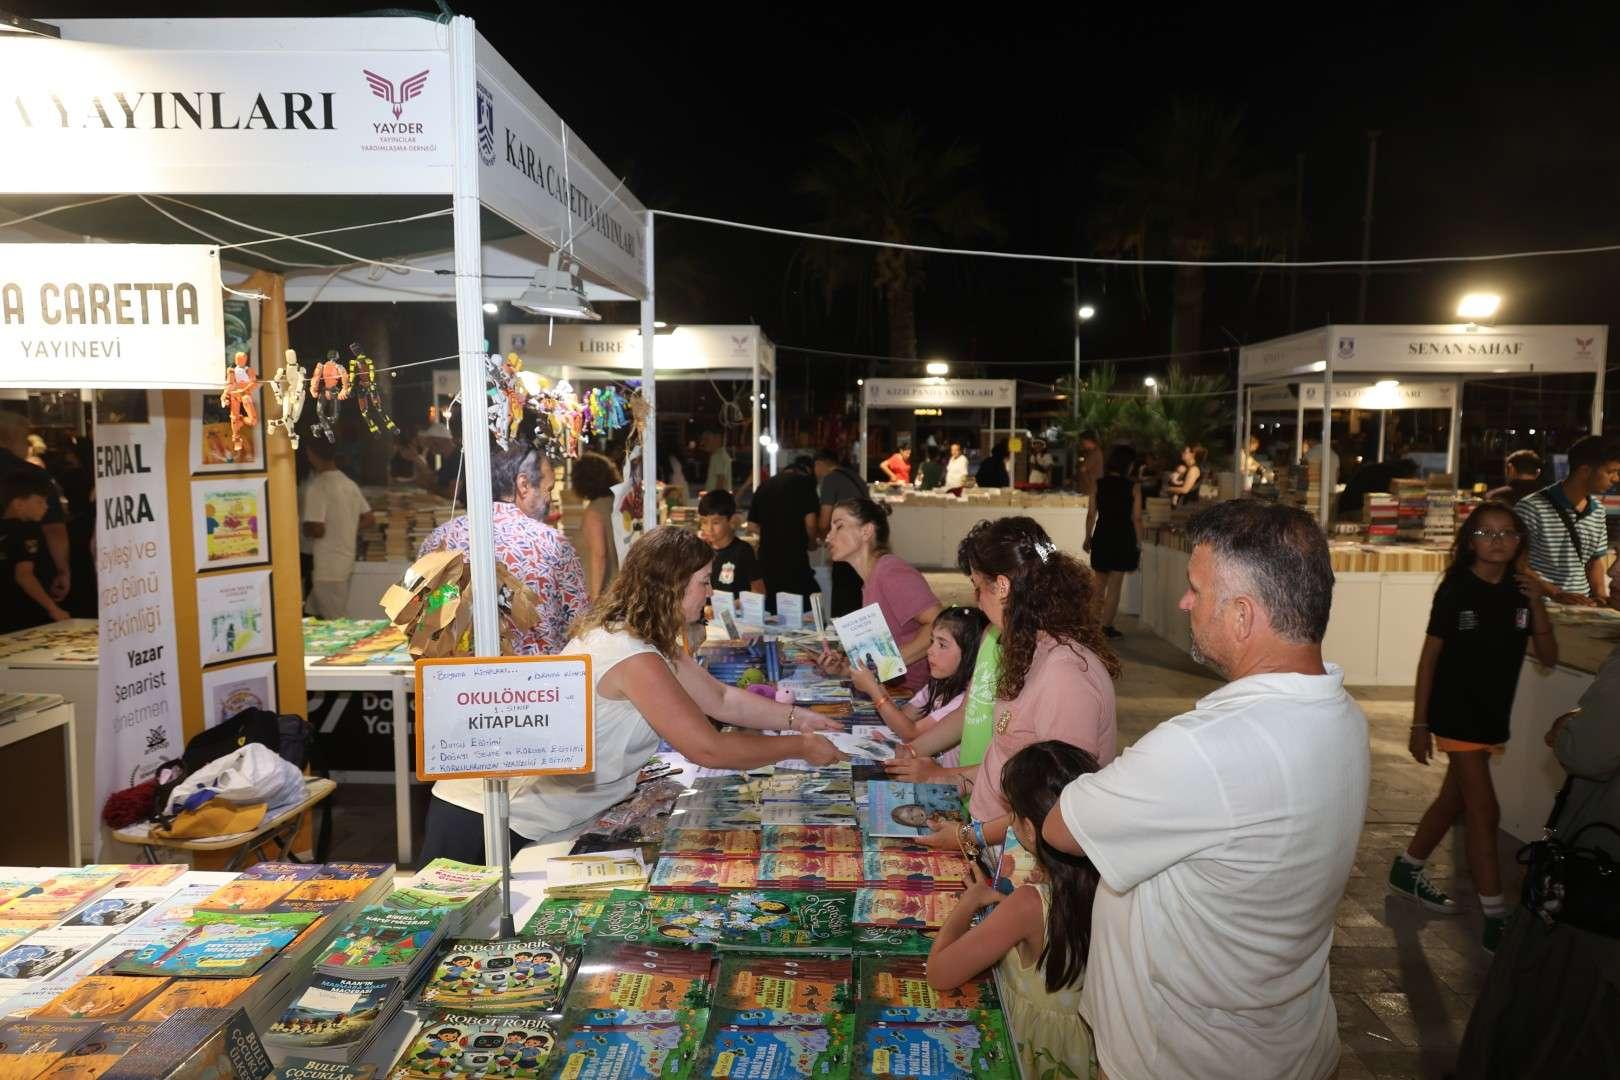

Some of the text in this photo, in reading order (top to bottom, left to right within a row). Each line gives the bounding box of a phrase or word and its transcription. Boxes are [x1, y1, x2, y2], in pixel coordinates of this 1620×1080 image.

[373, 122, 424, 134] YAYDER
[505, 127, 545, 189] KARA
[546, 165, 594, 227] CARETTA
[1, 282, 200, 325] A CARETTA
[20, 337, 121, 358] YAYINEVİ
[1408, 342, 1524, 355] SENAN SAHAF
[96, 443, 151, 478] ERDAL
[104, 493, 155, 531] KARA
[135, 540, 157, 560] ve
[127, 645, 164, 669] Yazar
[457, 686, 560, 706] OKULÖNCESİ
[468, 712, 550, 730] KİTAPLARI
[452, 939, 551, 953] ROBOT ROBİK
[443, 1013, 552, 1029] ROBOT ROBİK
[246, 1032, 271, 1072] BULUT
[304, 1061, 350, 1073] BULUT
